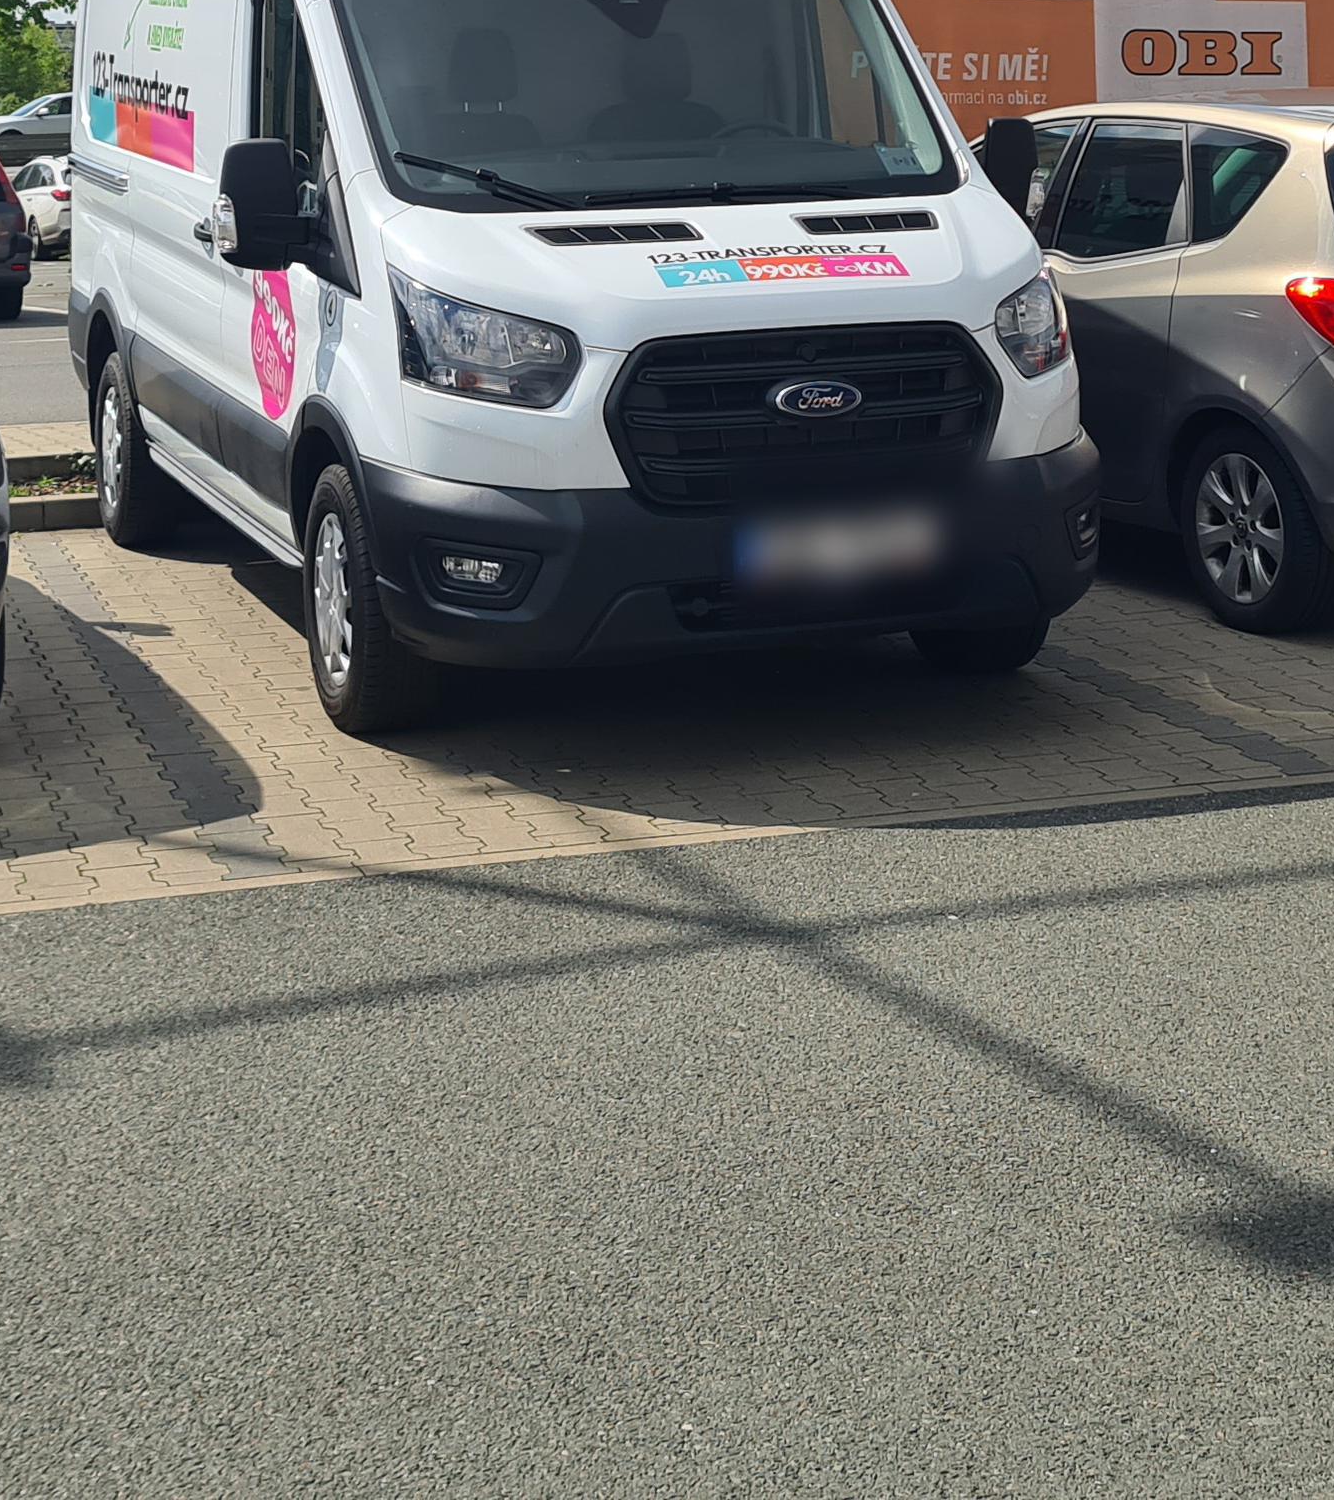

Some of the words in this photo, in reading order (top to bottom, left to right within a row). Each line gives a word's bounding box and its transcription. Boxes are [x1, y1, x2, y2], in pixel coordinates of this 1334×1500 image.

[1121, 28, 1283, 76] OBI
[962, 52, 990, 81] SI
[997, 47, 1049, 82] MĚ!
[93, 50, 189, 122] 123-Transporter.cz
[988, 92, 1004, 105] na
[1007, 89, 1048, 106] obi.cz
[647, 244, 893, 265] 123-TRANSPORTER.CZ
[678, 267, 732, 285] 24h
[745, 262, 830, 279] 990Kč
[797, 387, 844, 410] Ford
